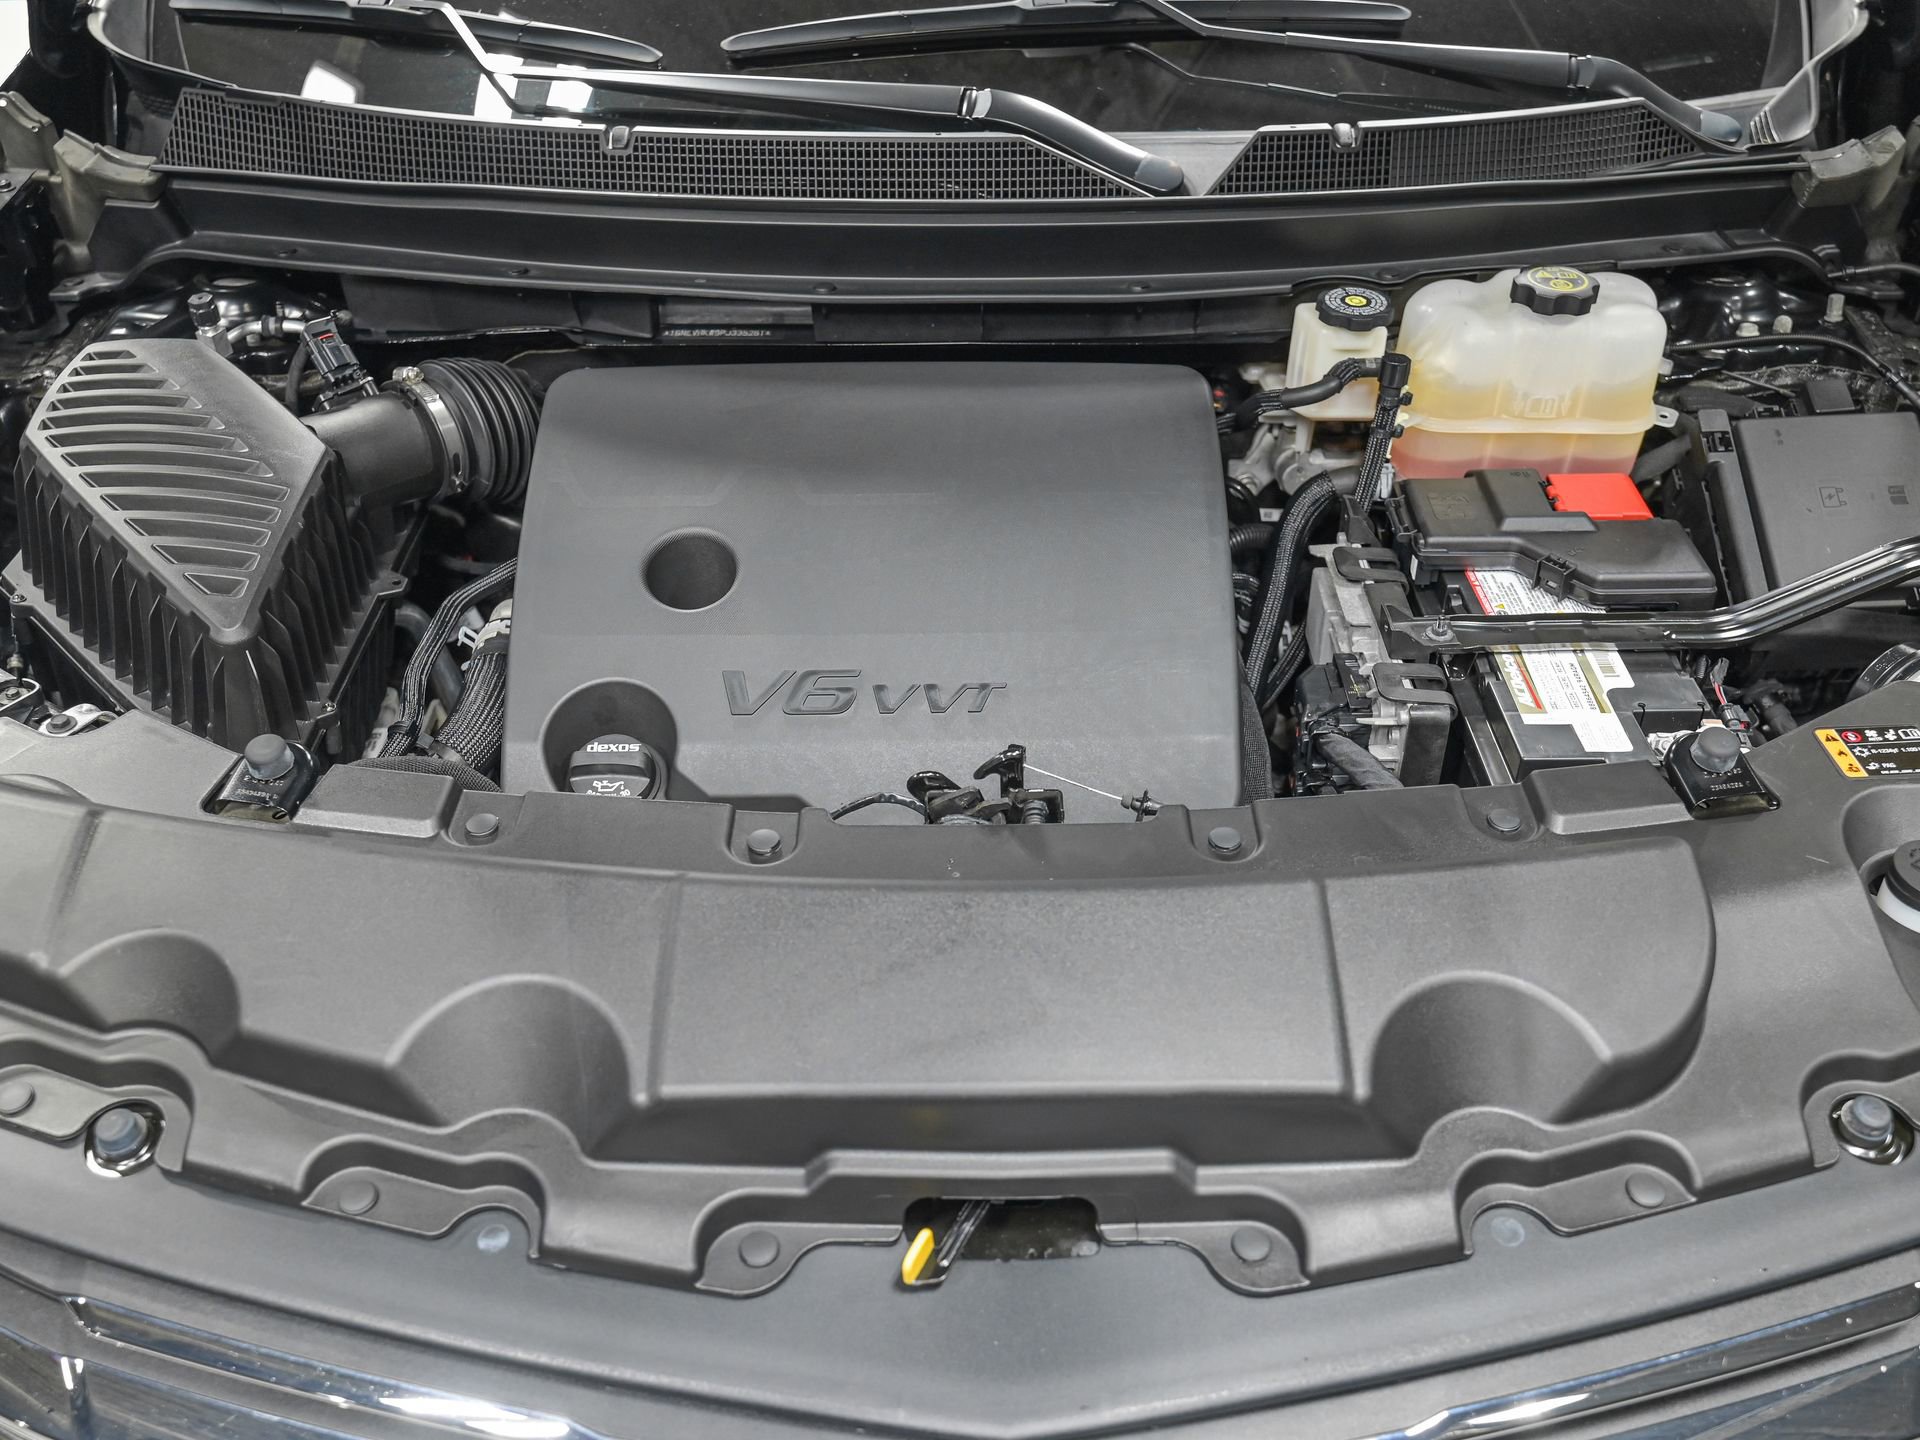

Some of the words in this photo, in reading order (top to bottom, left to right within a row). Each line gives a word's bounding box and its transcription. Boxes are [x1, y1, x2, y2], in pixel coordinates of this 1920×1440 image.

[721, 669, 862, 716] V6
[872, 682, 1008, 714] VVT
[1501, 652, 1536, 708] ACDelco
[586, 741, 642, 753] dexos
